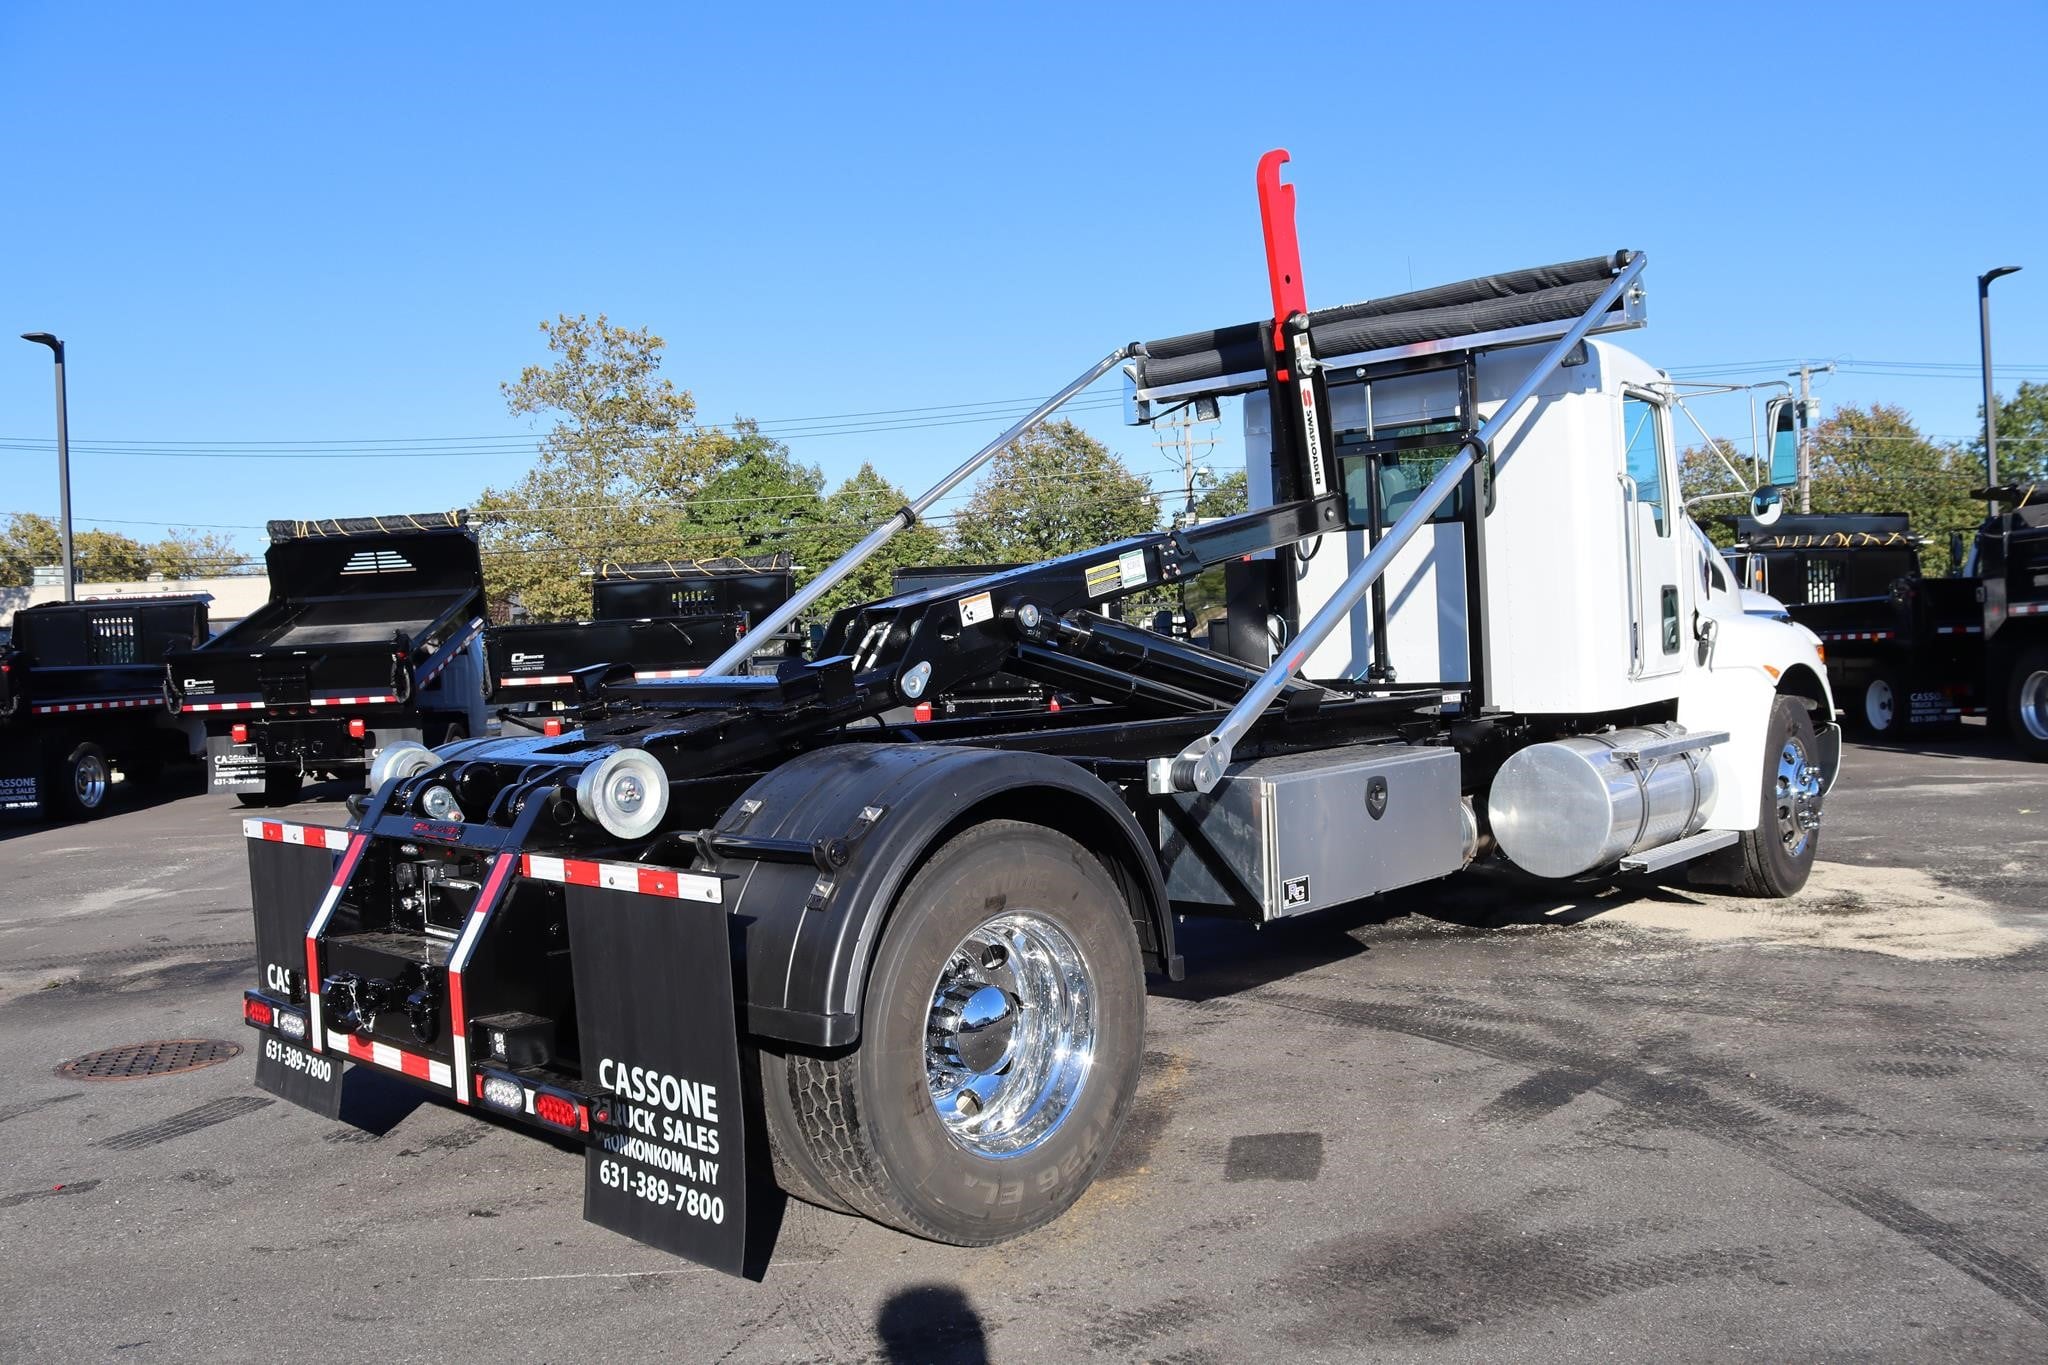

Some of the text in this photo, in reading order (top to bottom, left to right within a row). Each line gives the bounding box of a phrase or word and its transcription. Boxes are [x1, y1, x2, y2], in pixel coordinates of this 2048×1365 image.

[1306, 409, 1321, 485] SWAPLOADER
[265, 1038, 332, 1083] 631-389-7800
[599, 1058, 719, 1124] CASSONE
[663, 1116, 720, 1156] SALES
[599, 1159, 725, 1225] 631-389-7800
[699, 1158, 720, 1186] NY
